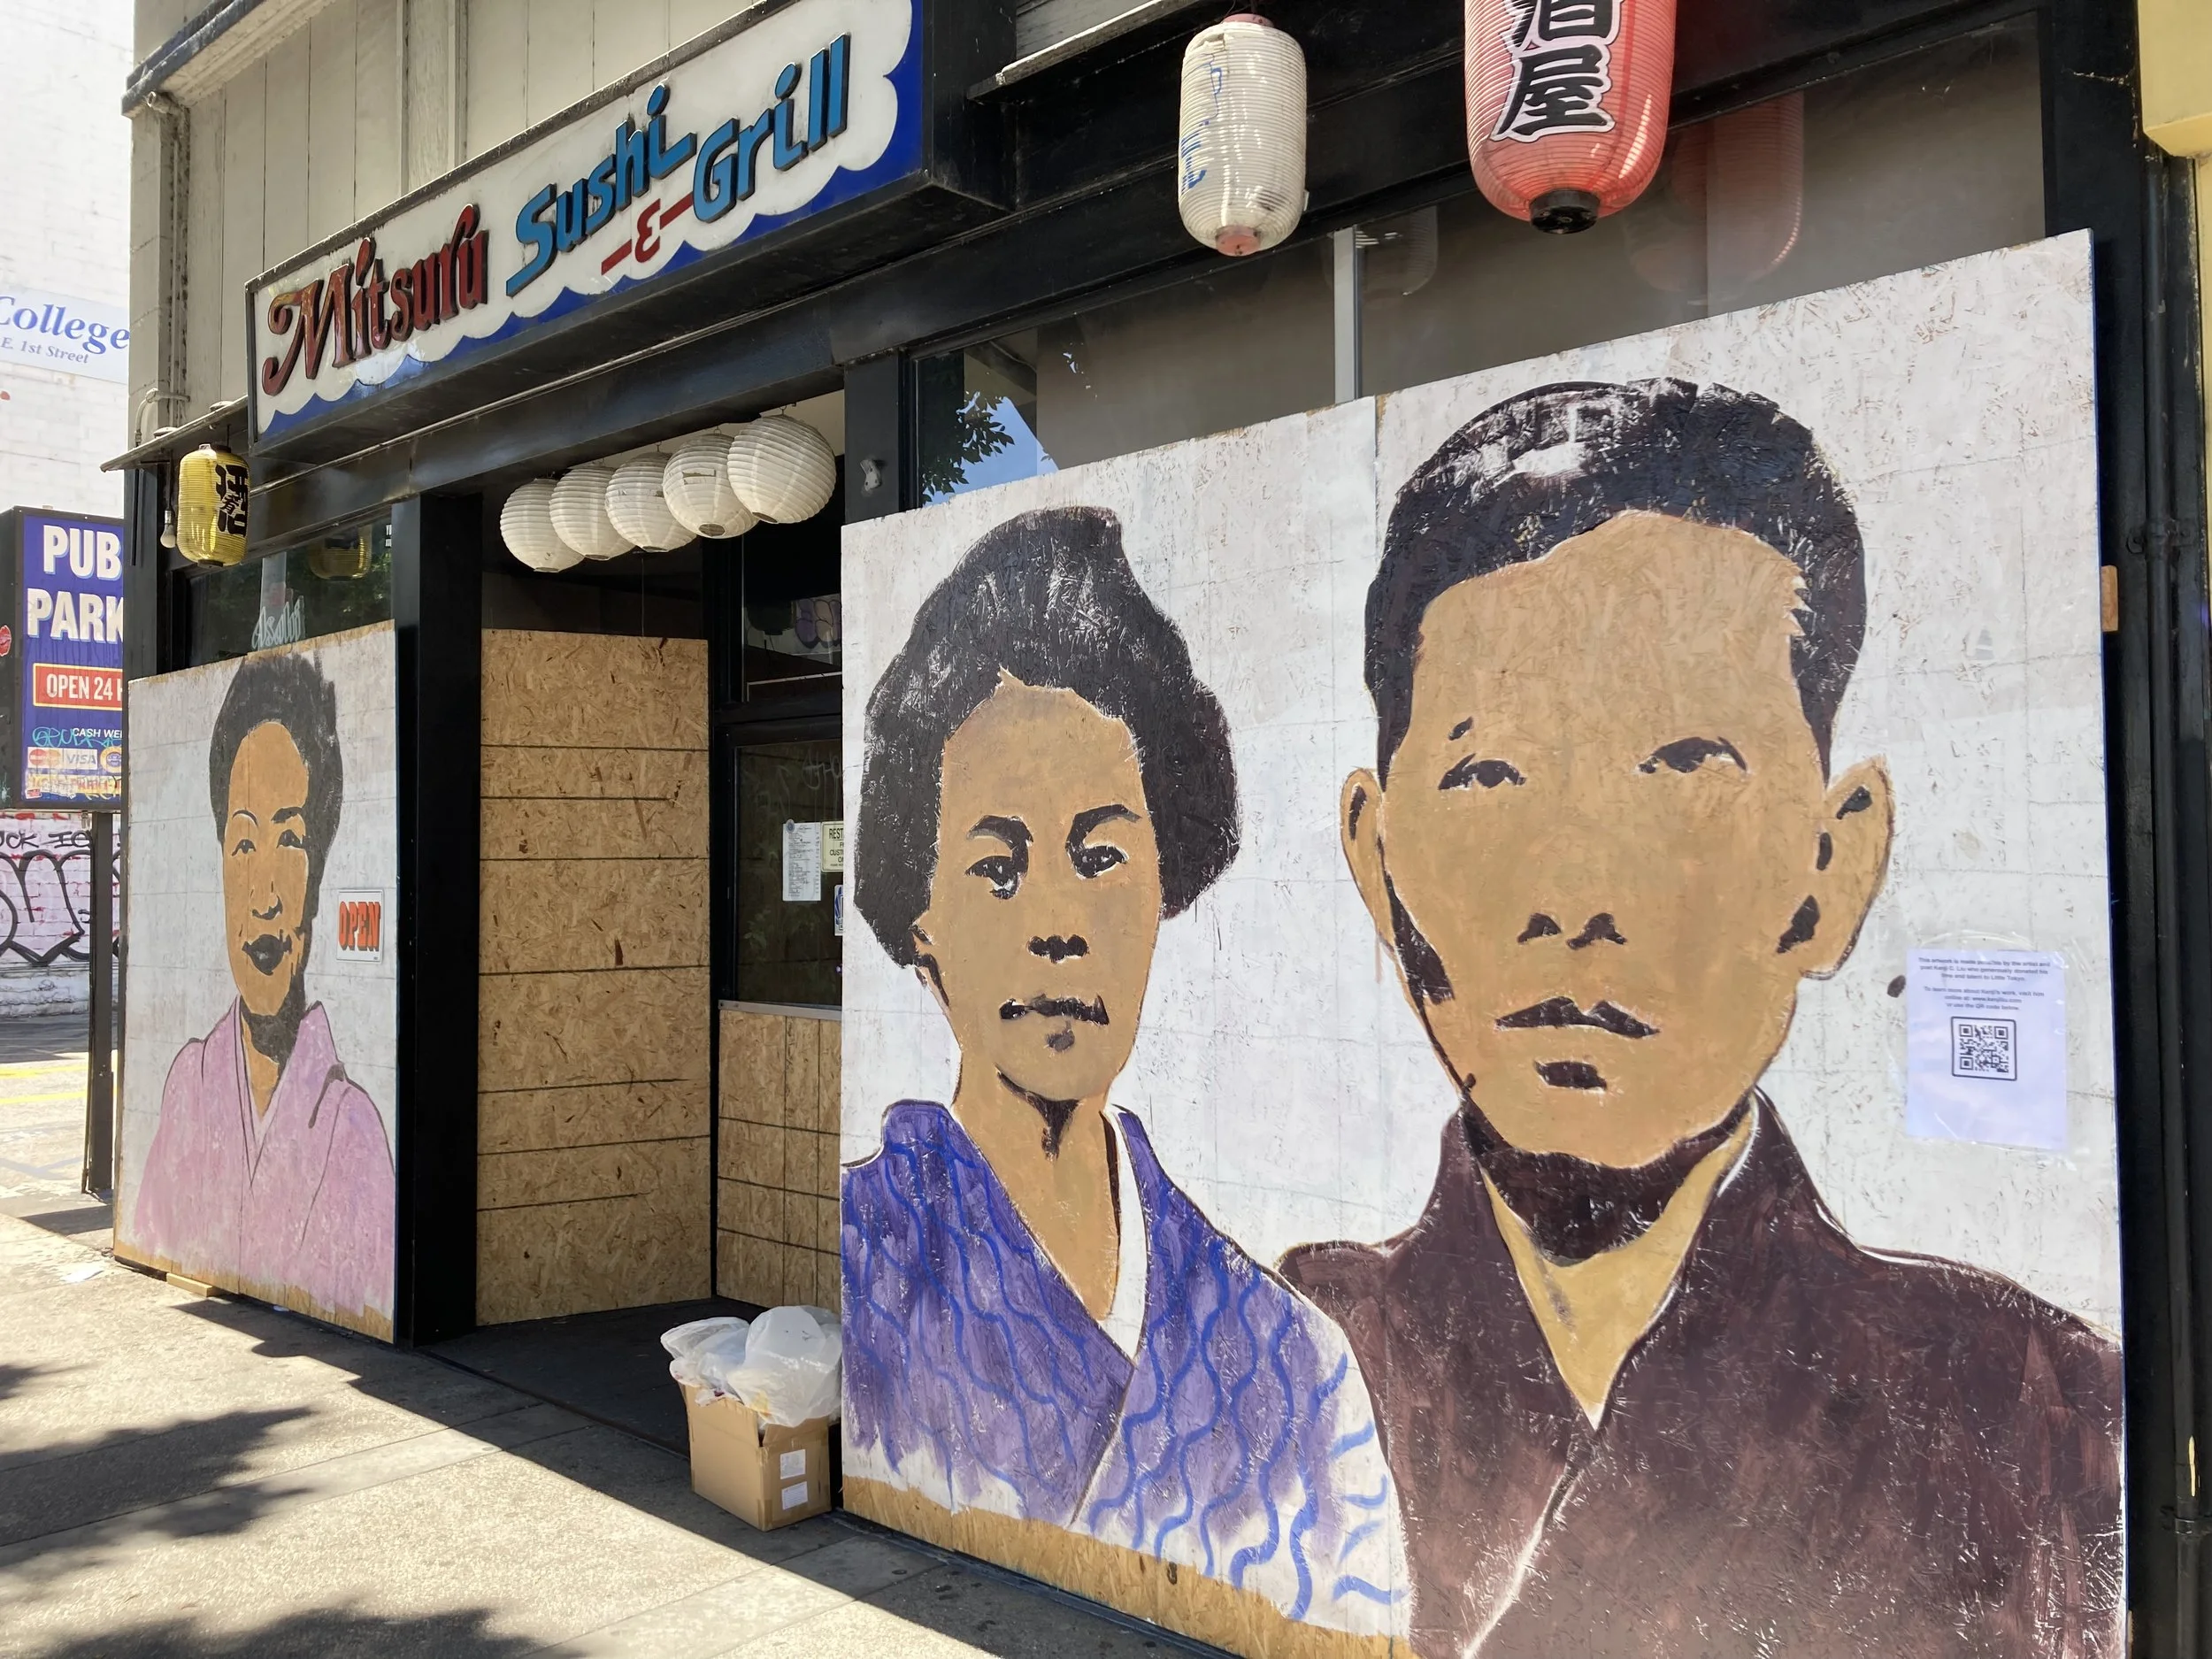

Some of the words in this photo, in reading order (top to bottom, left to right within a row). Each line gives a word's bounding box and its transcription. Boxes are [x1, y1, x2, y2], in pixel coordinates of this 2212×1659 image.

[262, 204, 490, 396] Mitsuru
[506, 83, 697, 296] Sushi
[693, 32, 850, 223] Grill
[0, 296, 129, 355] College
[20, 341, 42, 355] 1st
[46, 345, 88, 364] Street
[43, 525, 122, 580] PUB
[27, 588, 123, 644] PARK
[46, 673, 89, 700] OPEN
[94, 676, 113, 701] 24
[73, 727, 101, 738] CASH
[66, 754, 96, 764] VISA
[339, 901, 380, 951] OPEN
